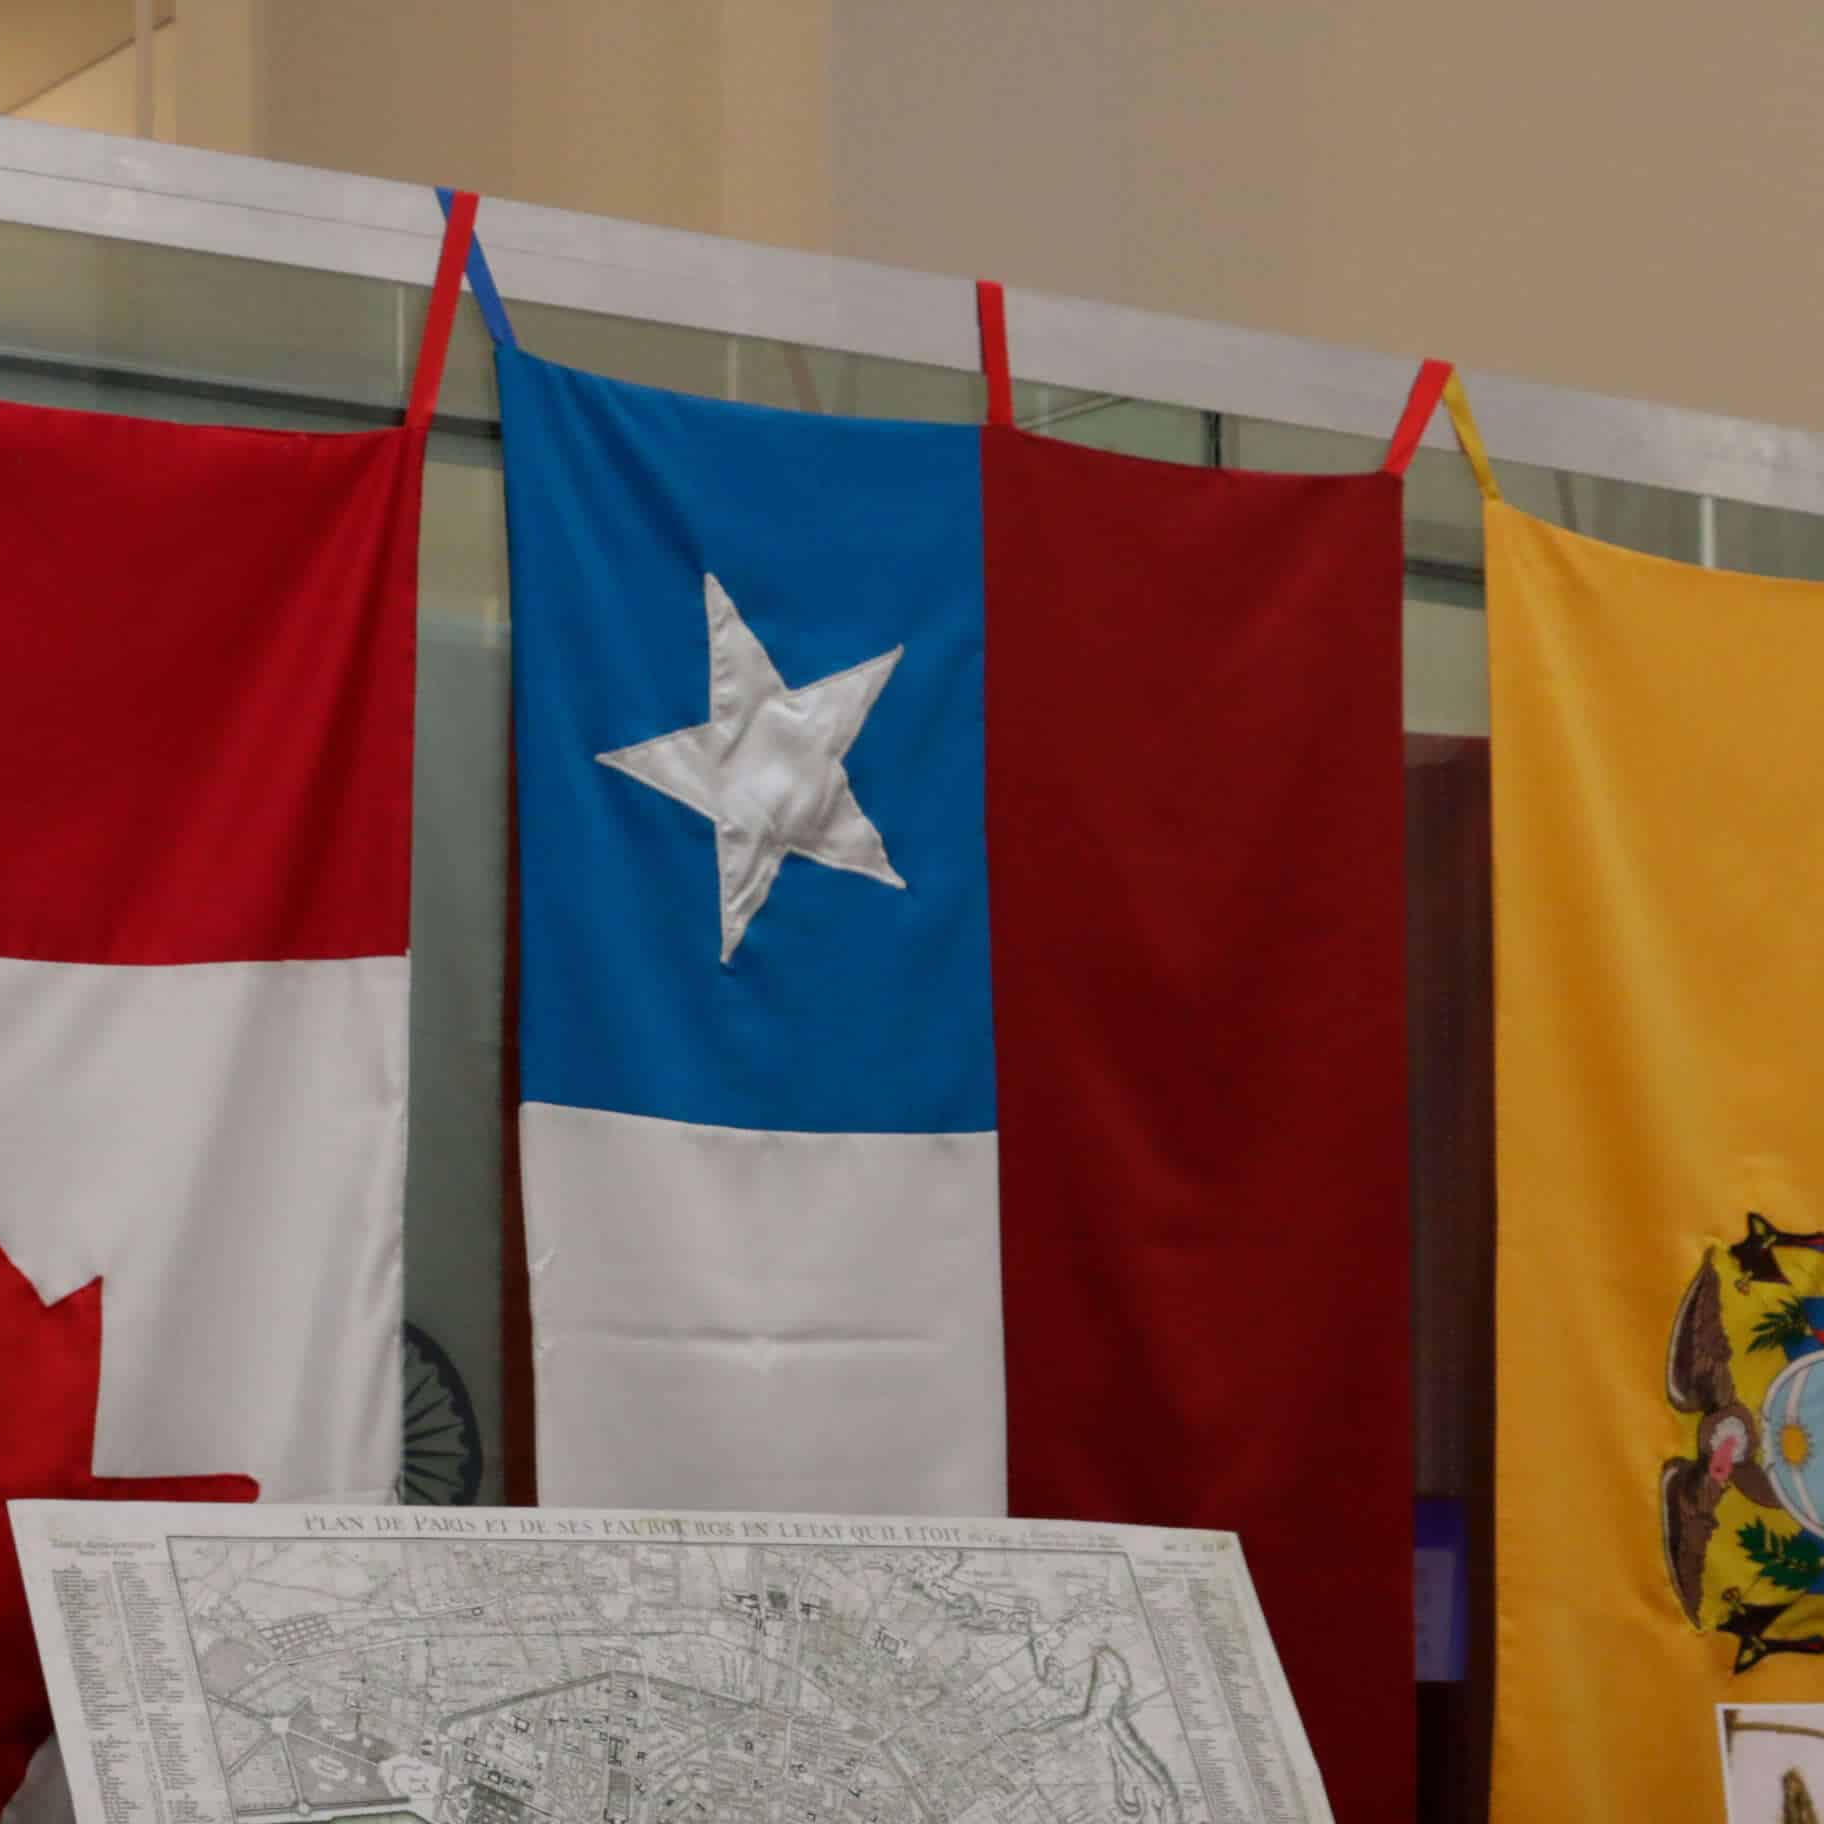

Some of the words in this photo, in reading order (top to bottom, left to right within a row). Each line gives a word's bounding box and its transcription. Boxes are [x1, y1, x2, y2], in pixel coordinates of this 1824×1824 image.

[305, 1514, 364, 1532] PLAN
[376, 1514, 406, 1533] DE
[484, 1518, 512, 1534] ET
[520, 1517, 548, 1534] DE
